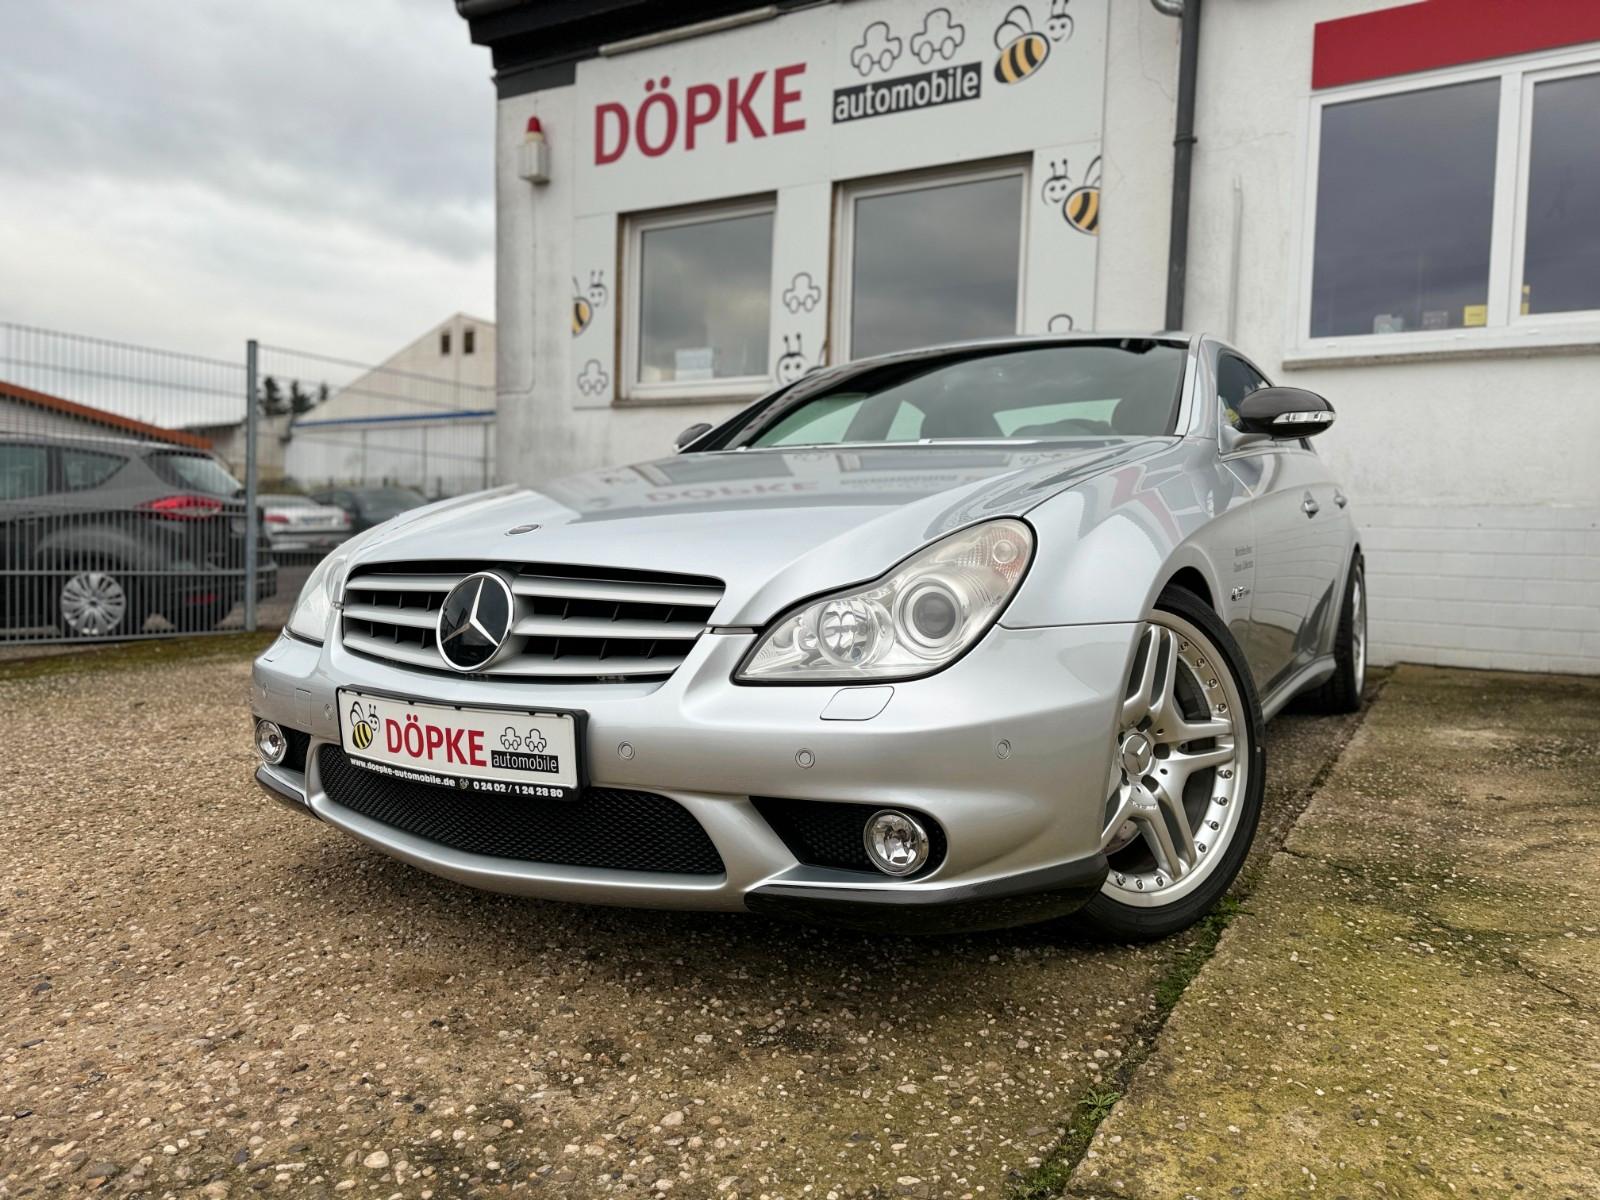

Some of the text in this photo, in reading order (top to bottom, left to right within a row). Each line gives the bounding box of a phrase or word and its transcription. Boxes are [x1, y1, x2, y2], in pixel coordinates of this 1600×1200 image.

[595, 63, 807, 166] DÖPKE
[834, 67, 980, 121] automobile
[385, 713, 487, 767] DÖPKE
[493, 753, 558, 773] automobile
[350, 758, 456, 787] www.doepke-automobile.de
